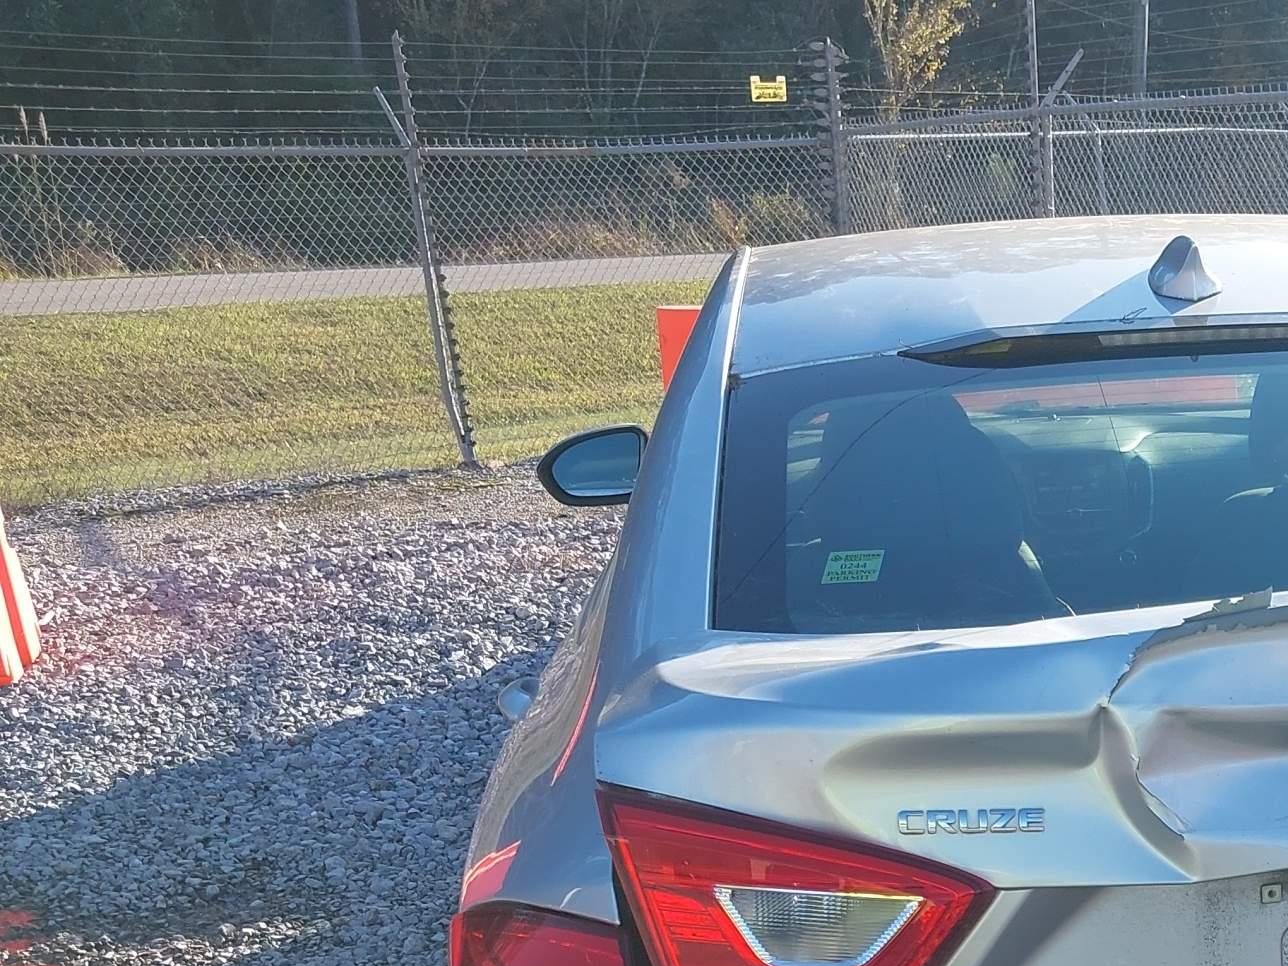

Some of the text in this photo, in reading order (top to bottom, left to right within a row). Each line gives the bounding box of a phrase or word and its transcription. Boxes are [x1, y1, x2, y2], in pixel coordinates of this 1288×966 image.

[840, 562, 868, 570] 0244
[827, 569, 877, 577] PARKING
[897, 807, 1046, 835] CRUZE
